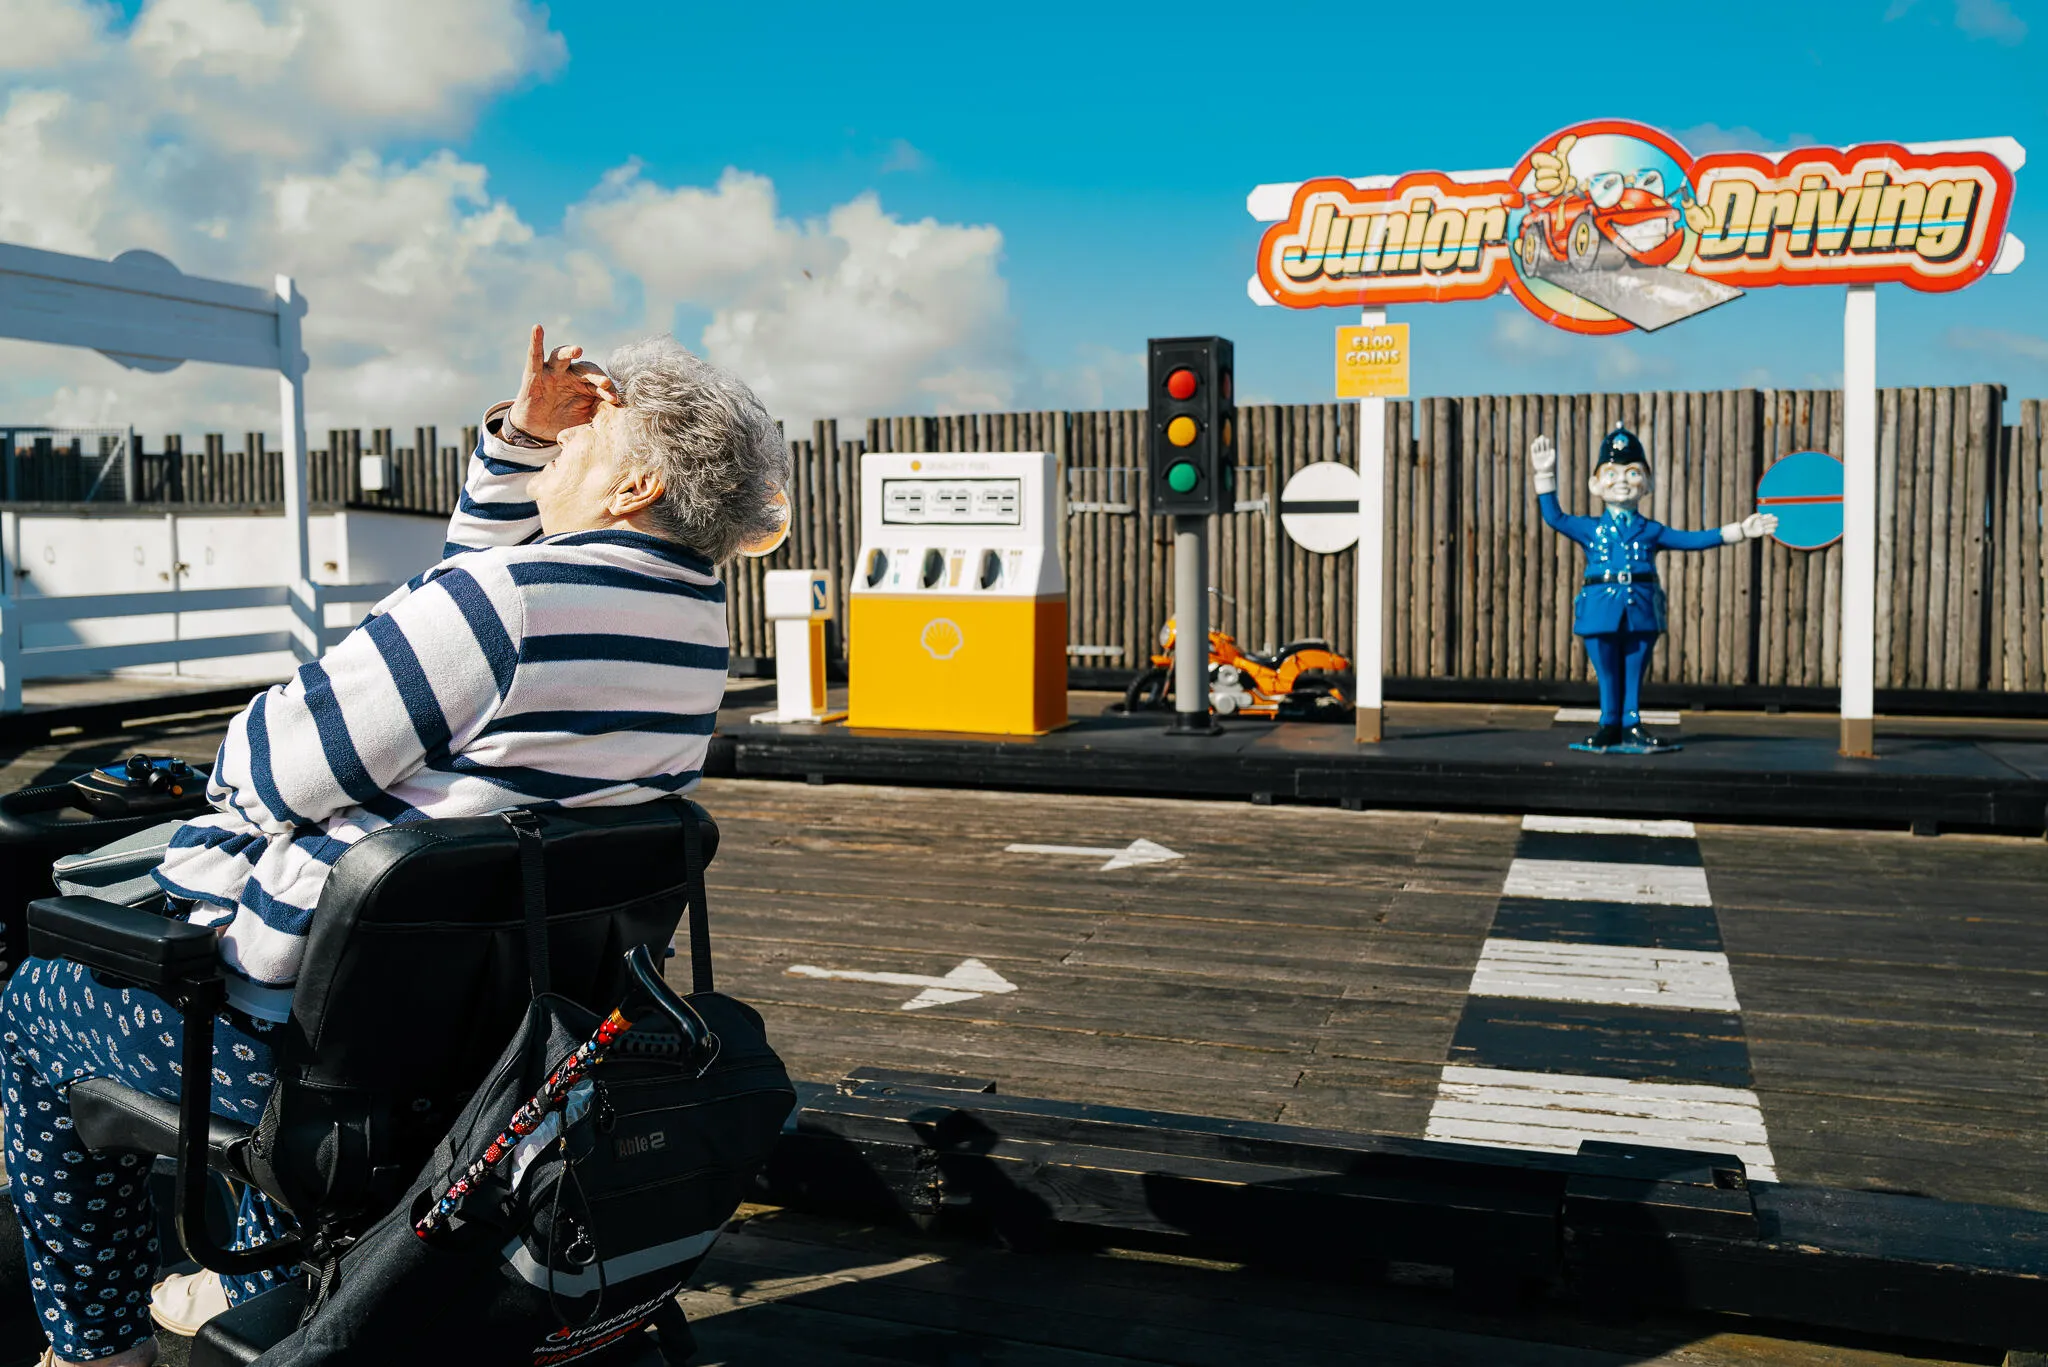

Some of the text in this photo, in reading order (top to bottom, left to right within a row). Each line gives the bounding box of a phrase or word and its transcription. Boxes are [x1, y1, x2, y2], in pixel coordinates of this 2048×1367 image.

[1281, 170, 1982, 283] Junior Driving
[1351, 335, 1395, 350] £1.00
[1345, 350, 1401, 366] COINS
